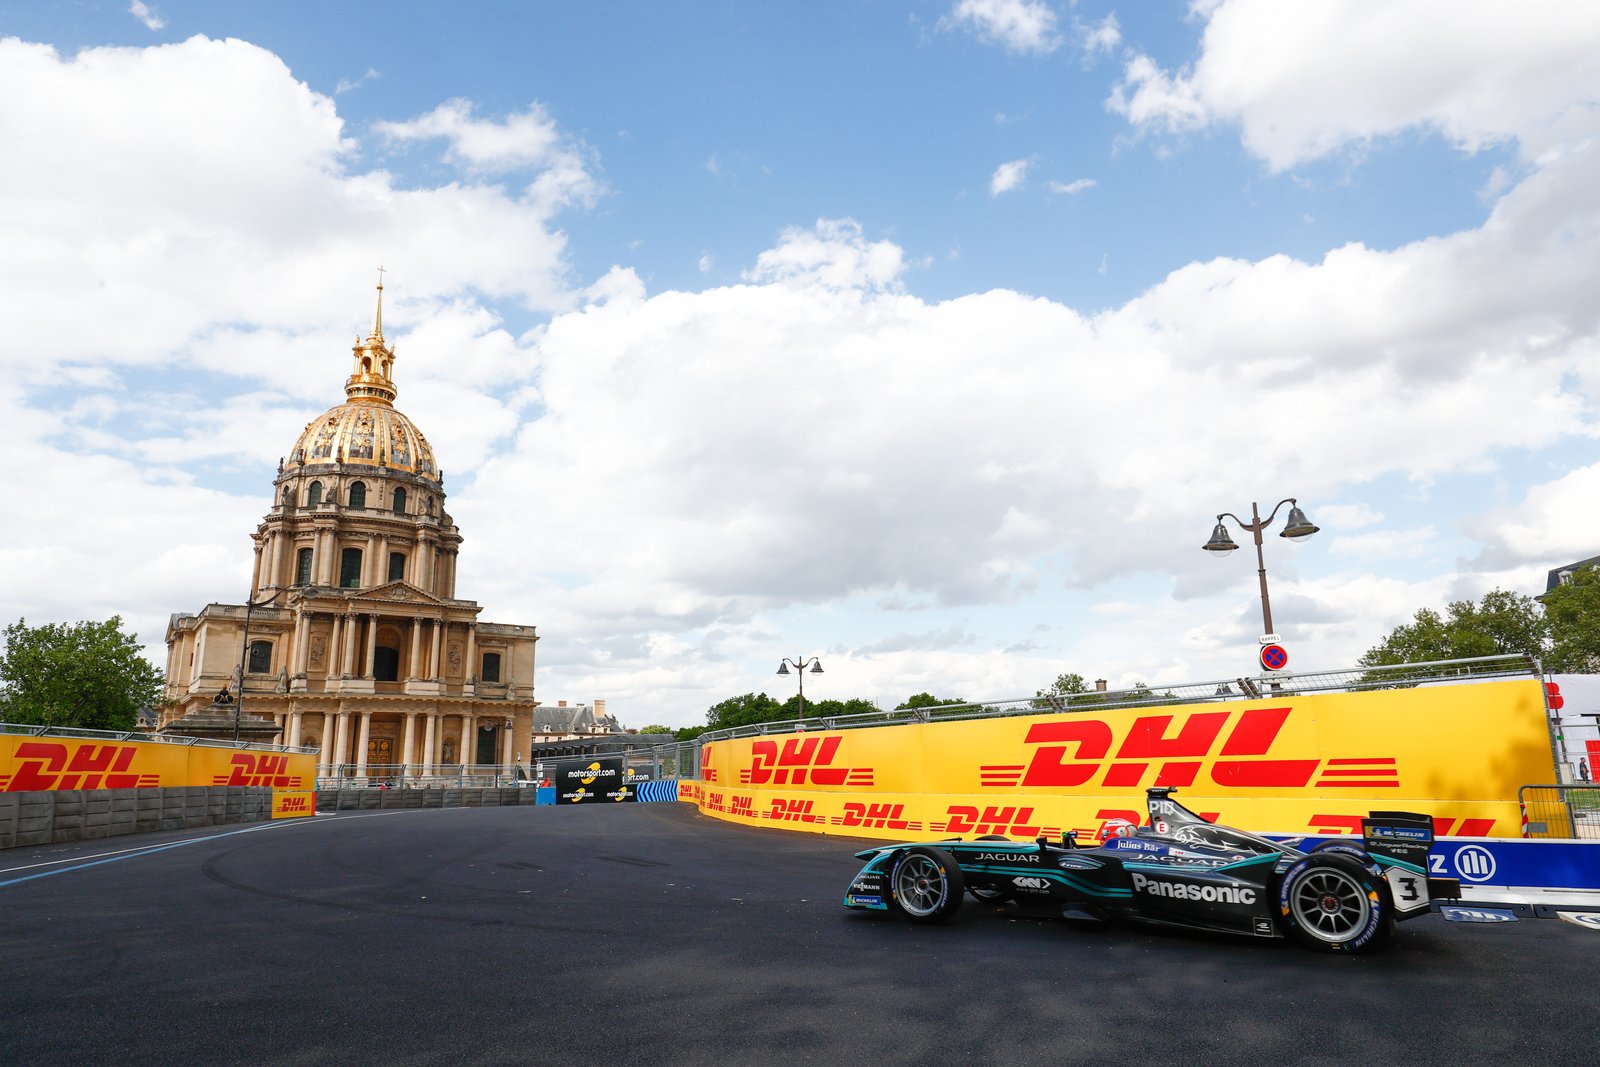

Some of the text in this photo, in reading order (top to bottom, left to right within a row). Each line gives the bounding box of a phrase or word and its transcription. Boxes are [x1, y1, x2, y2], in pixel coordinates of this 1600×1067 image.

[750, 736, 848, 785] DHL
[1021, 707, 1320, 787] DHL
[6, 742, 138, 793] DHL
[228, 753, 290, 787] DHL
[568, 769, 615, 778] motorsport.com
[281, 797, 307, 812] DHL
[731, 796, 753, 818] DHL
[770, 799, 818, 823] DHL
[842, 802, 909, 830] DHL
[945, 806, 1041, 837] DHL
[975, 852, 1040, 863] JAGUAR
[1116, 839, 1161, 853] Julius Bär
[1131, 872, 1257, 905] Panasonic
[1398, 877, 1419, 901] 3
[1355, 908, 1380, 948] MICHELIN
